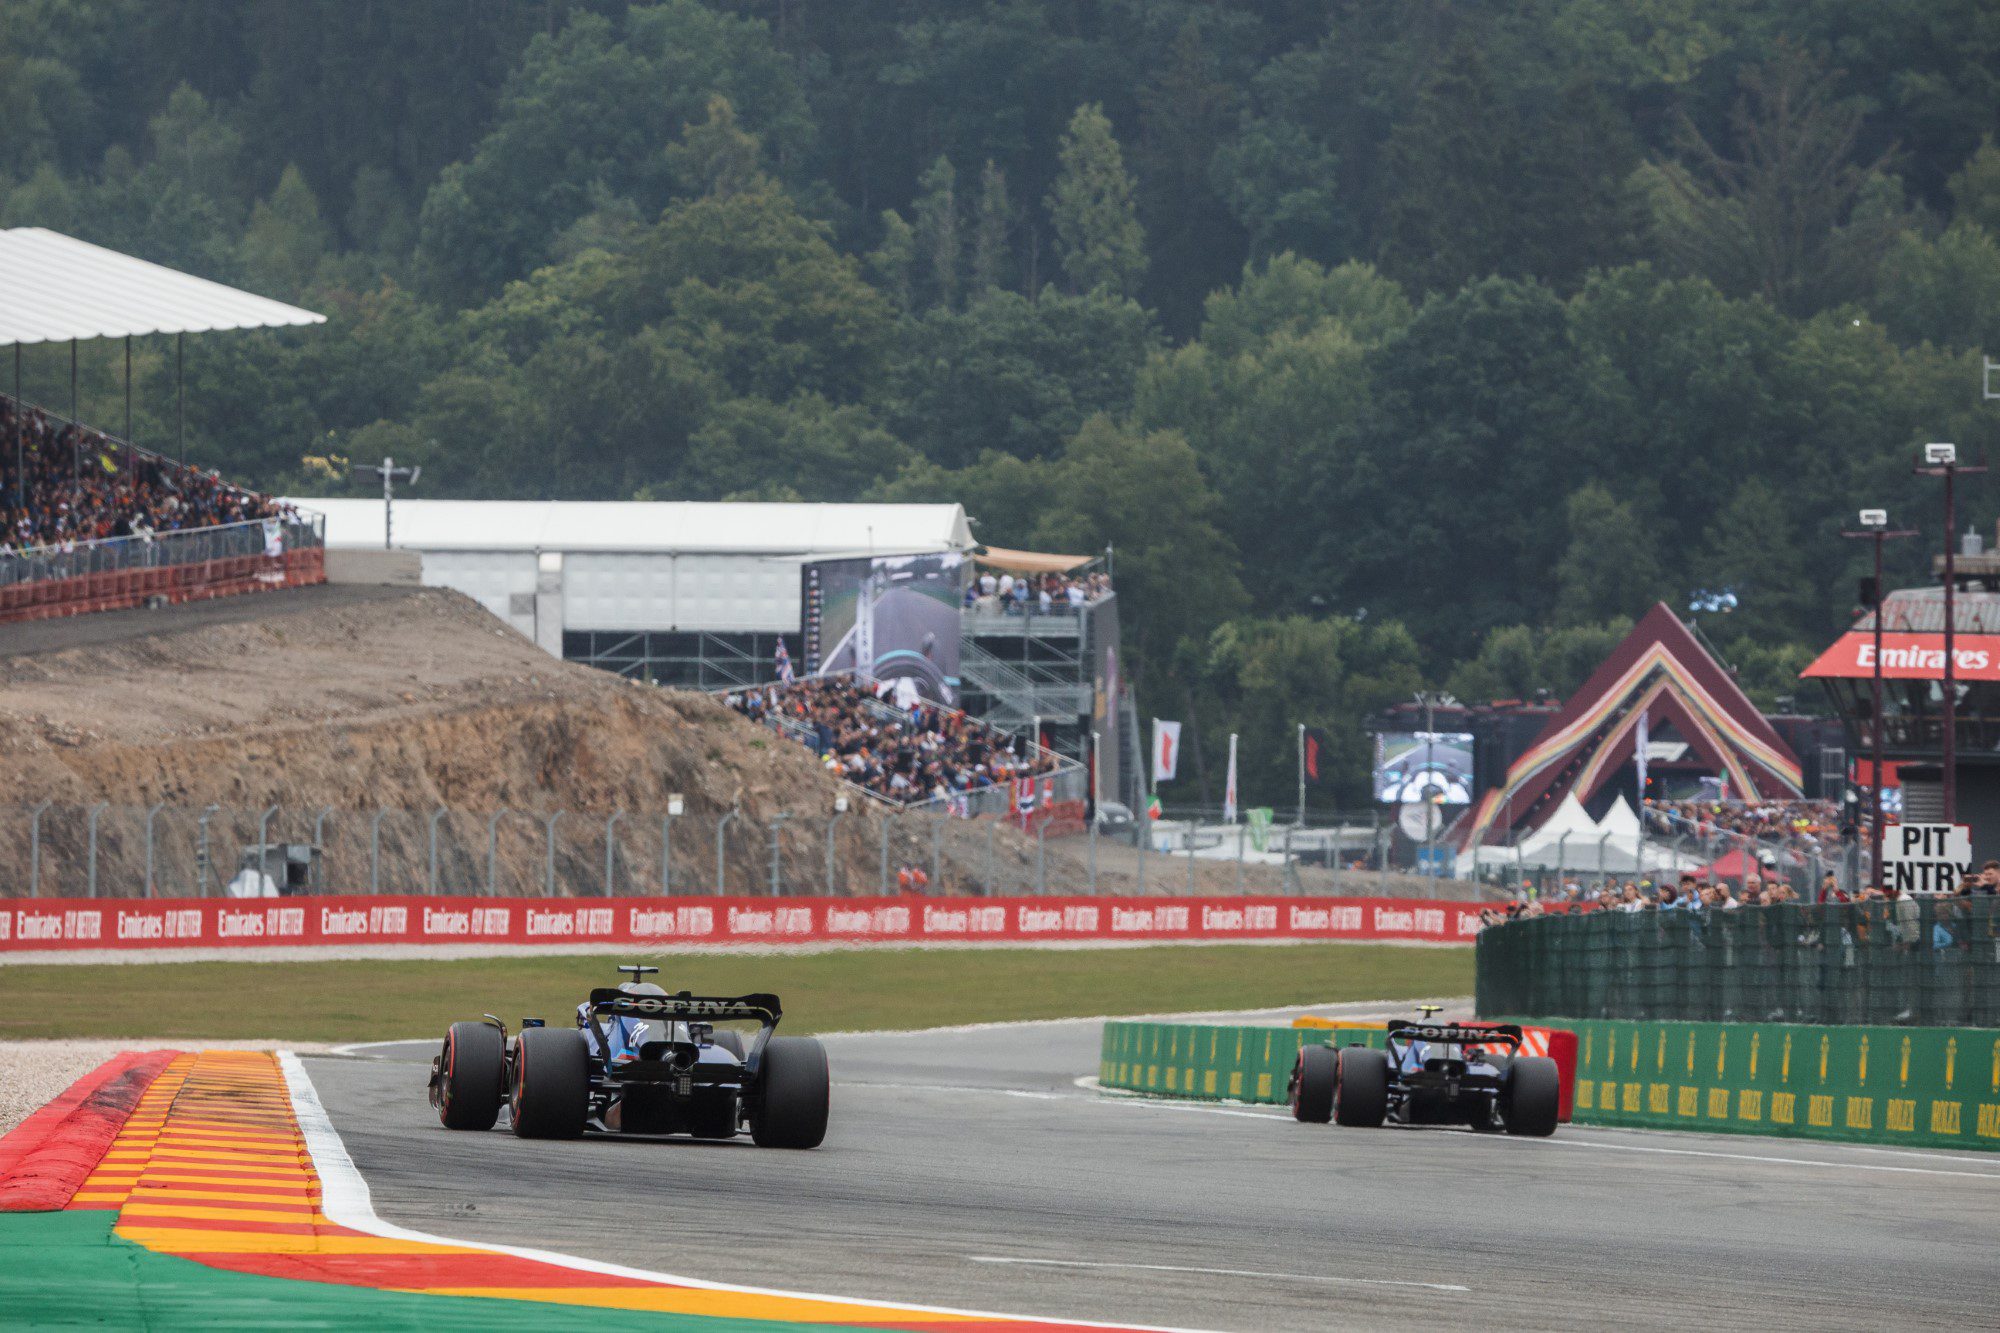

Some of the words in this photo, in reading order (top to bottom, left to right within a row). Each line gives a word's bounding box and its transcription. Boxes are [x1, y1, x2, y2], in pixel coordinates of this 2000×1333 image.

[1903, 826, 1950, 856] PIT
[17, 910, 62, 939] Emirates
[118, 910, 162, 939] Emirates
[218, 908, 264, 937] Emirates
[322, 907, 367, 935] Emirates
[424, 906, 469, 934] Emirates
[526, 908, 573, 935] Emirates
[613, 997, 752, 1015] SOFINA
